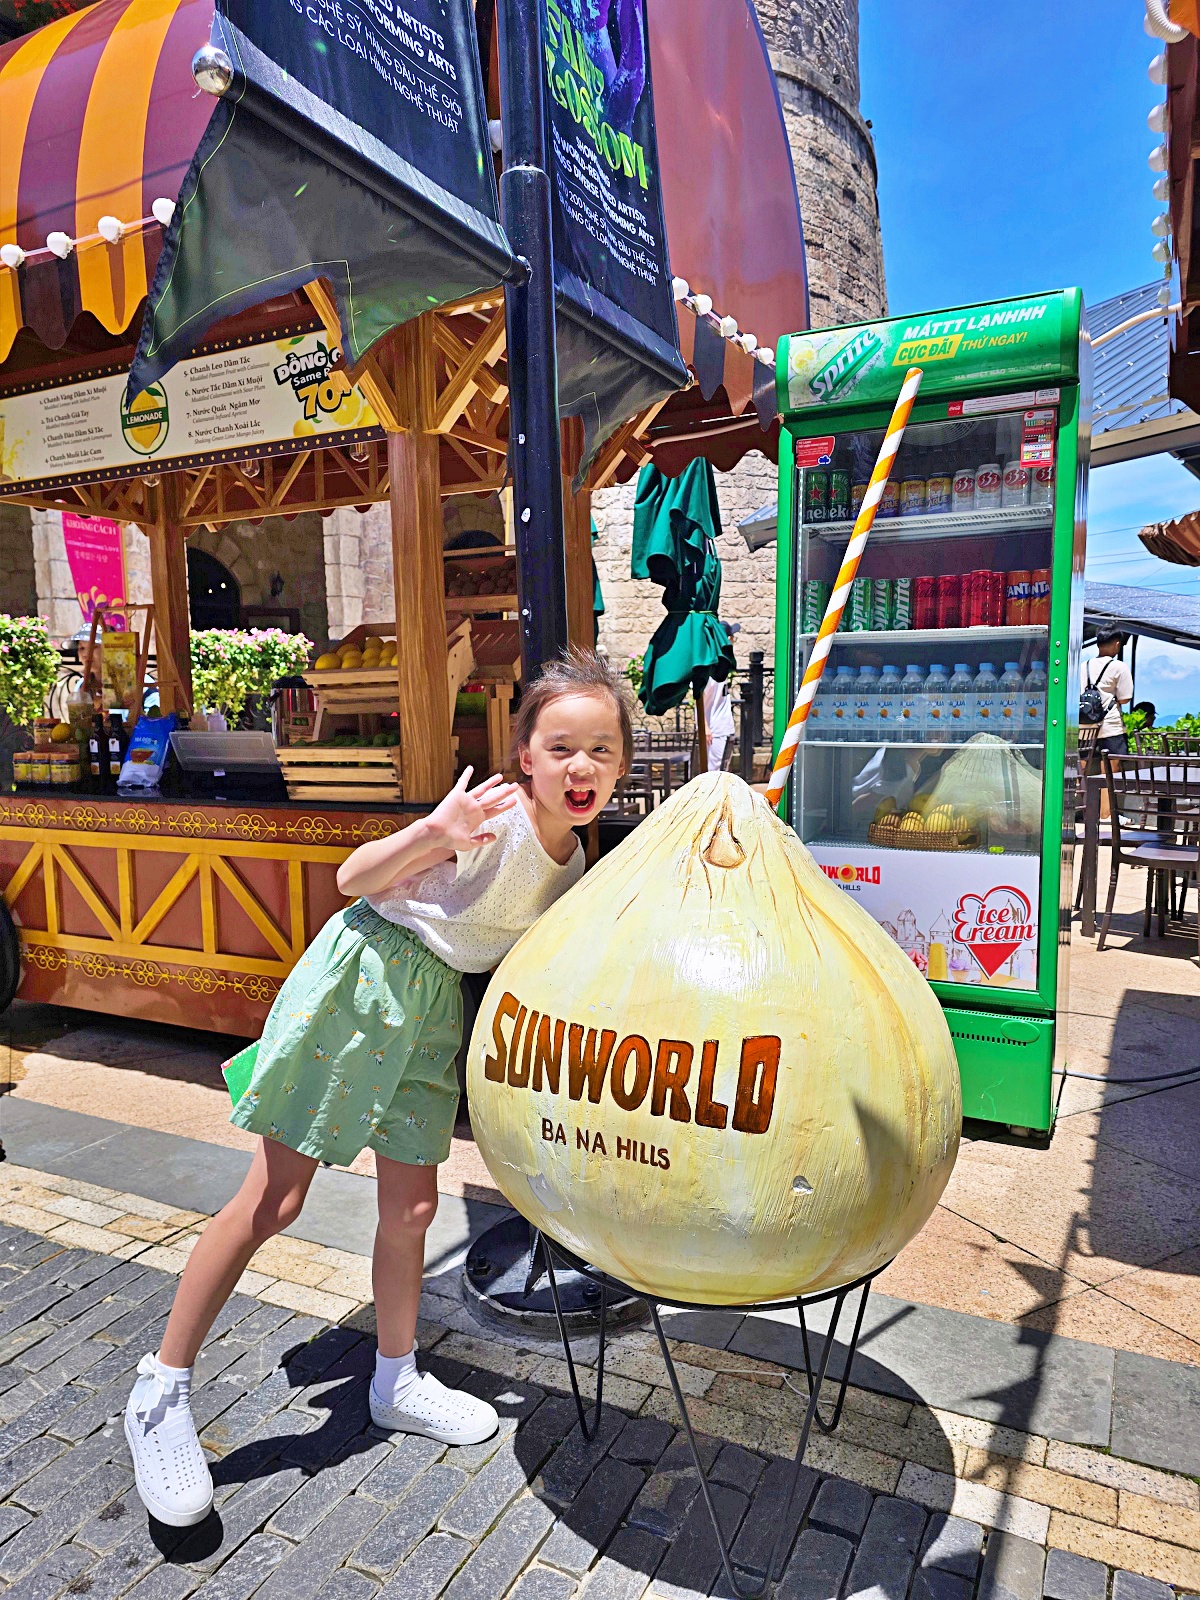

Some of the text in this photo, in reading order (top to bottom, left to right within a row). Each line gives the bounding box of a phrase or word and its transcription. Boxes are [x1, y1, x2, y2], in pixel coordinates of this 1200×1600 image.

[397, 5, 445, 50] ARTISTS
[427, 50, 457, 80] ARTS
[337, 27, 368, 60] LOẠI
[393, 80, 424, 113] NGHỆ
[424, 101, 459, 134] THUẬT
[417, 77, 440, 101] THẾ
[618, 200, 647, 227] ARTISTS
[638, 226, 656, 247] ARTS
[903, 305, 1047, 340] MÁTTT LẠNHHH
[898, 338, 954, 363] CỰC ĐÃ!
[961, 331, 1028, 351] THỬ NGAY!
[190, 365, 210, 375] Chanh
[812, 329, 876, 399] Sprite
[192, 385, 209, 395] Nước
[211, 383, 221, 391] Tắc
[246, 375, 263, 384] Muội
[293, 370, 322, 387] Same
[54, 413, 70, 421] Chanh
[80, 410, 89, 418] Tay
[126, 411, 163, 425] LEMONADE
[192, 407, 210, 416] Nước
[47, 434, 63, 442] Chanh
[194, 427, 212, 437] Nước
[213, 423, 233, 433] Chanh
[234, 421, 249, 430] Xoài
[250, 419, 261, 427] Lắc
[977, 903, 1012, 924] ice
[954, 920, 1037, 943] Cream
[484, 991, 782, 1135] SUNWORLD
[541, 1117, 671, 1171] BA NA HILLS
